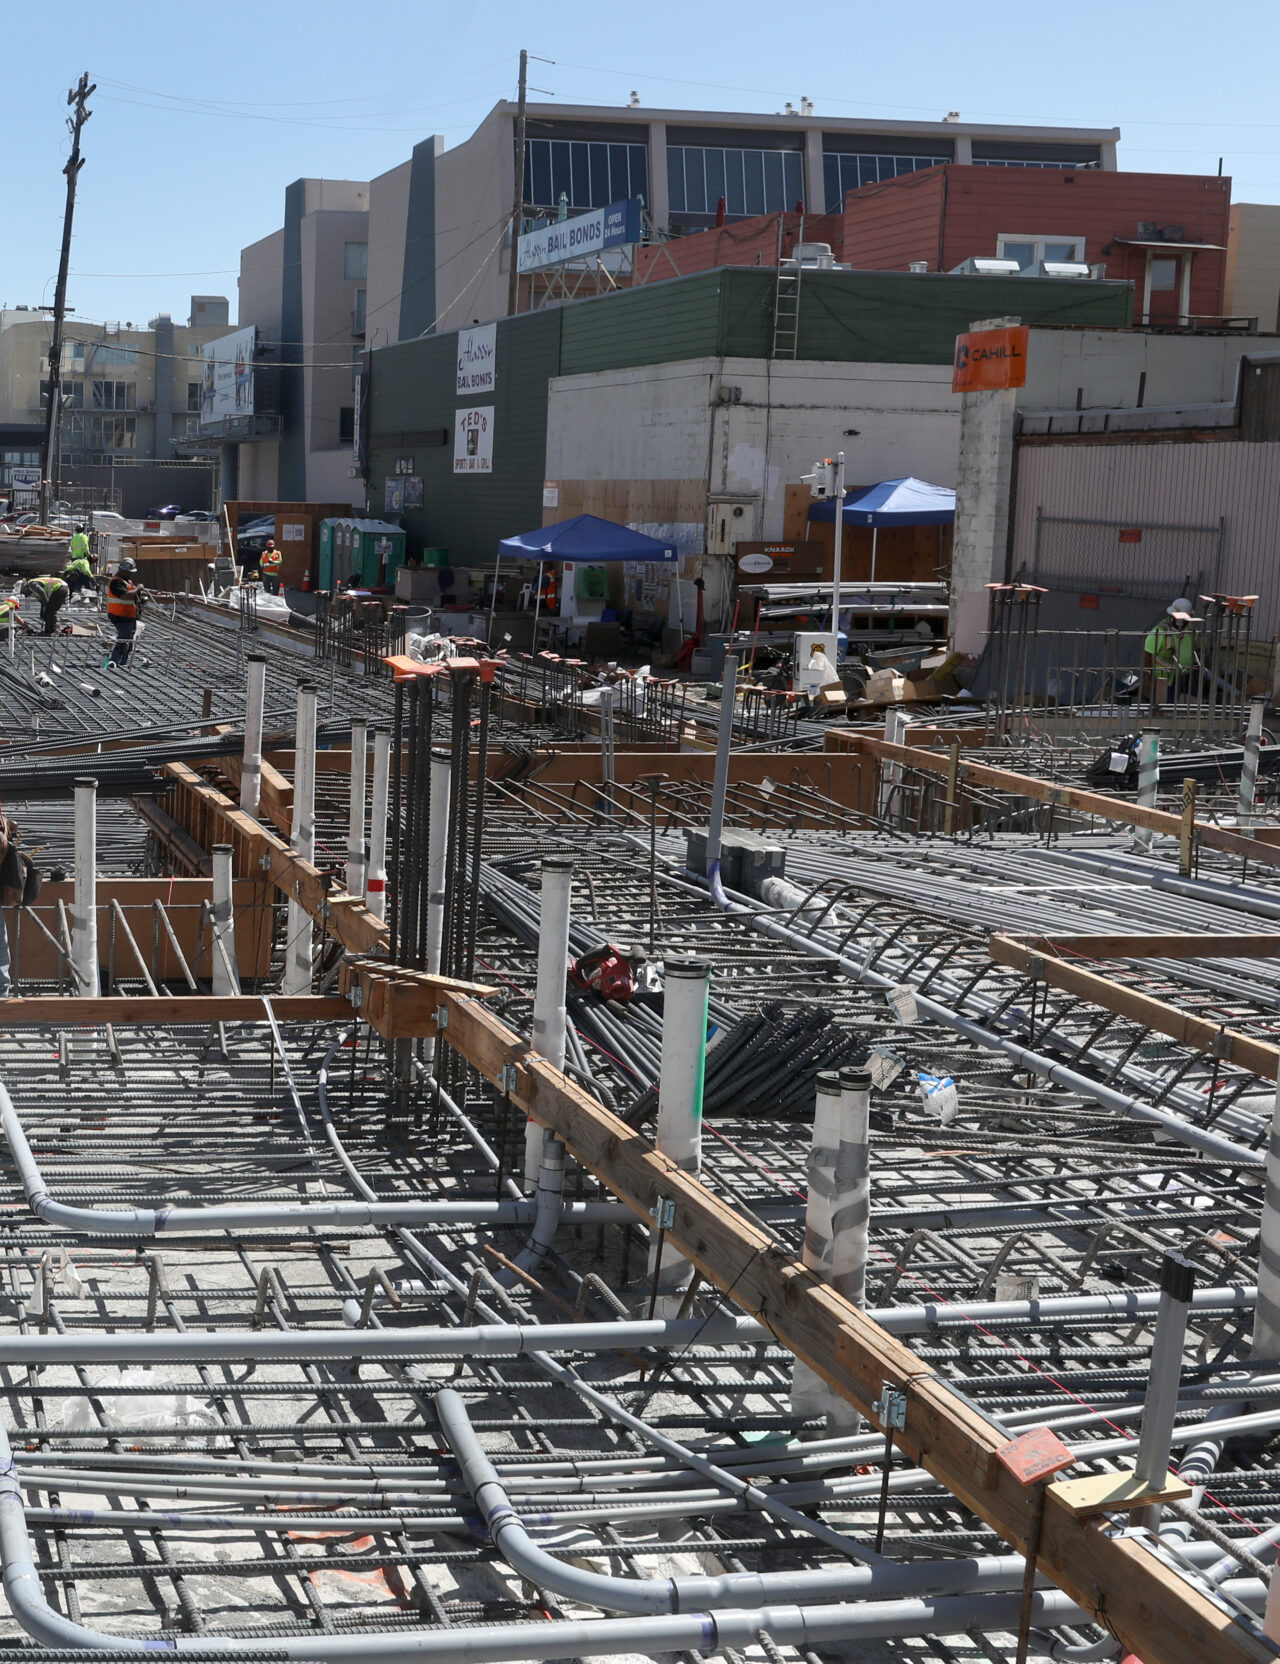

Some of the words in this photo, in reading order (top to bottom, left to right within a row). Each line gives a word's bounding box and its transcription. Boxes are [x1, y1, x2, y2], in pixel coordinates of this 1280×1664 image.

[608, 212, 622, 224] OPEN
[547, 235, 567, 253] BAIL
[569, 221, 601, 246] BONDS
[972, 345, 1021, 361] CAHILL
[461, 411, 488, 432] TED'S
